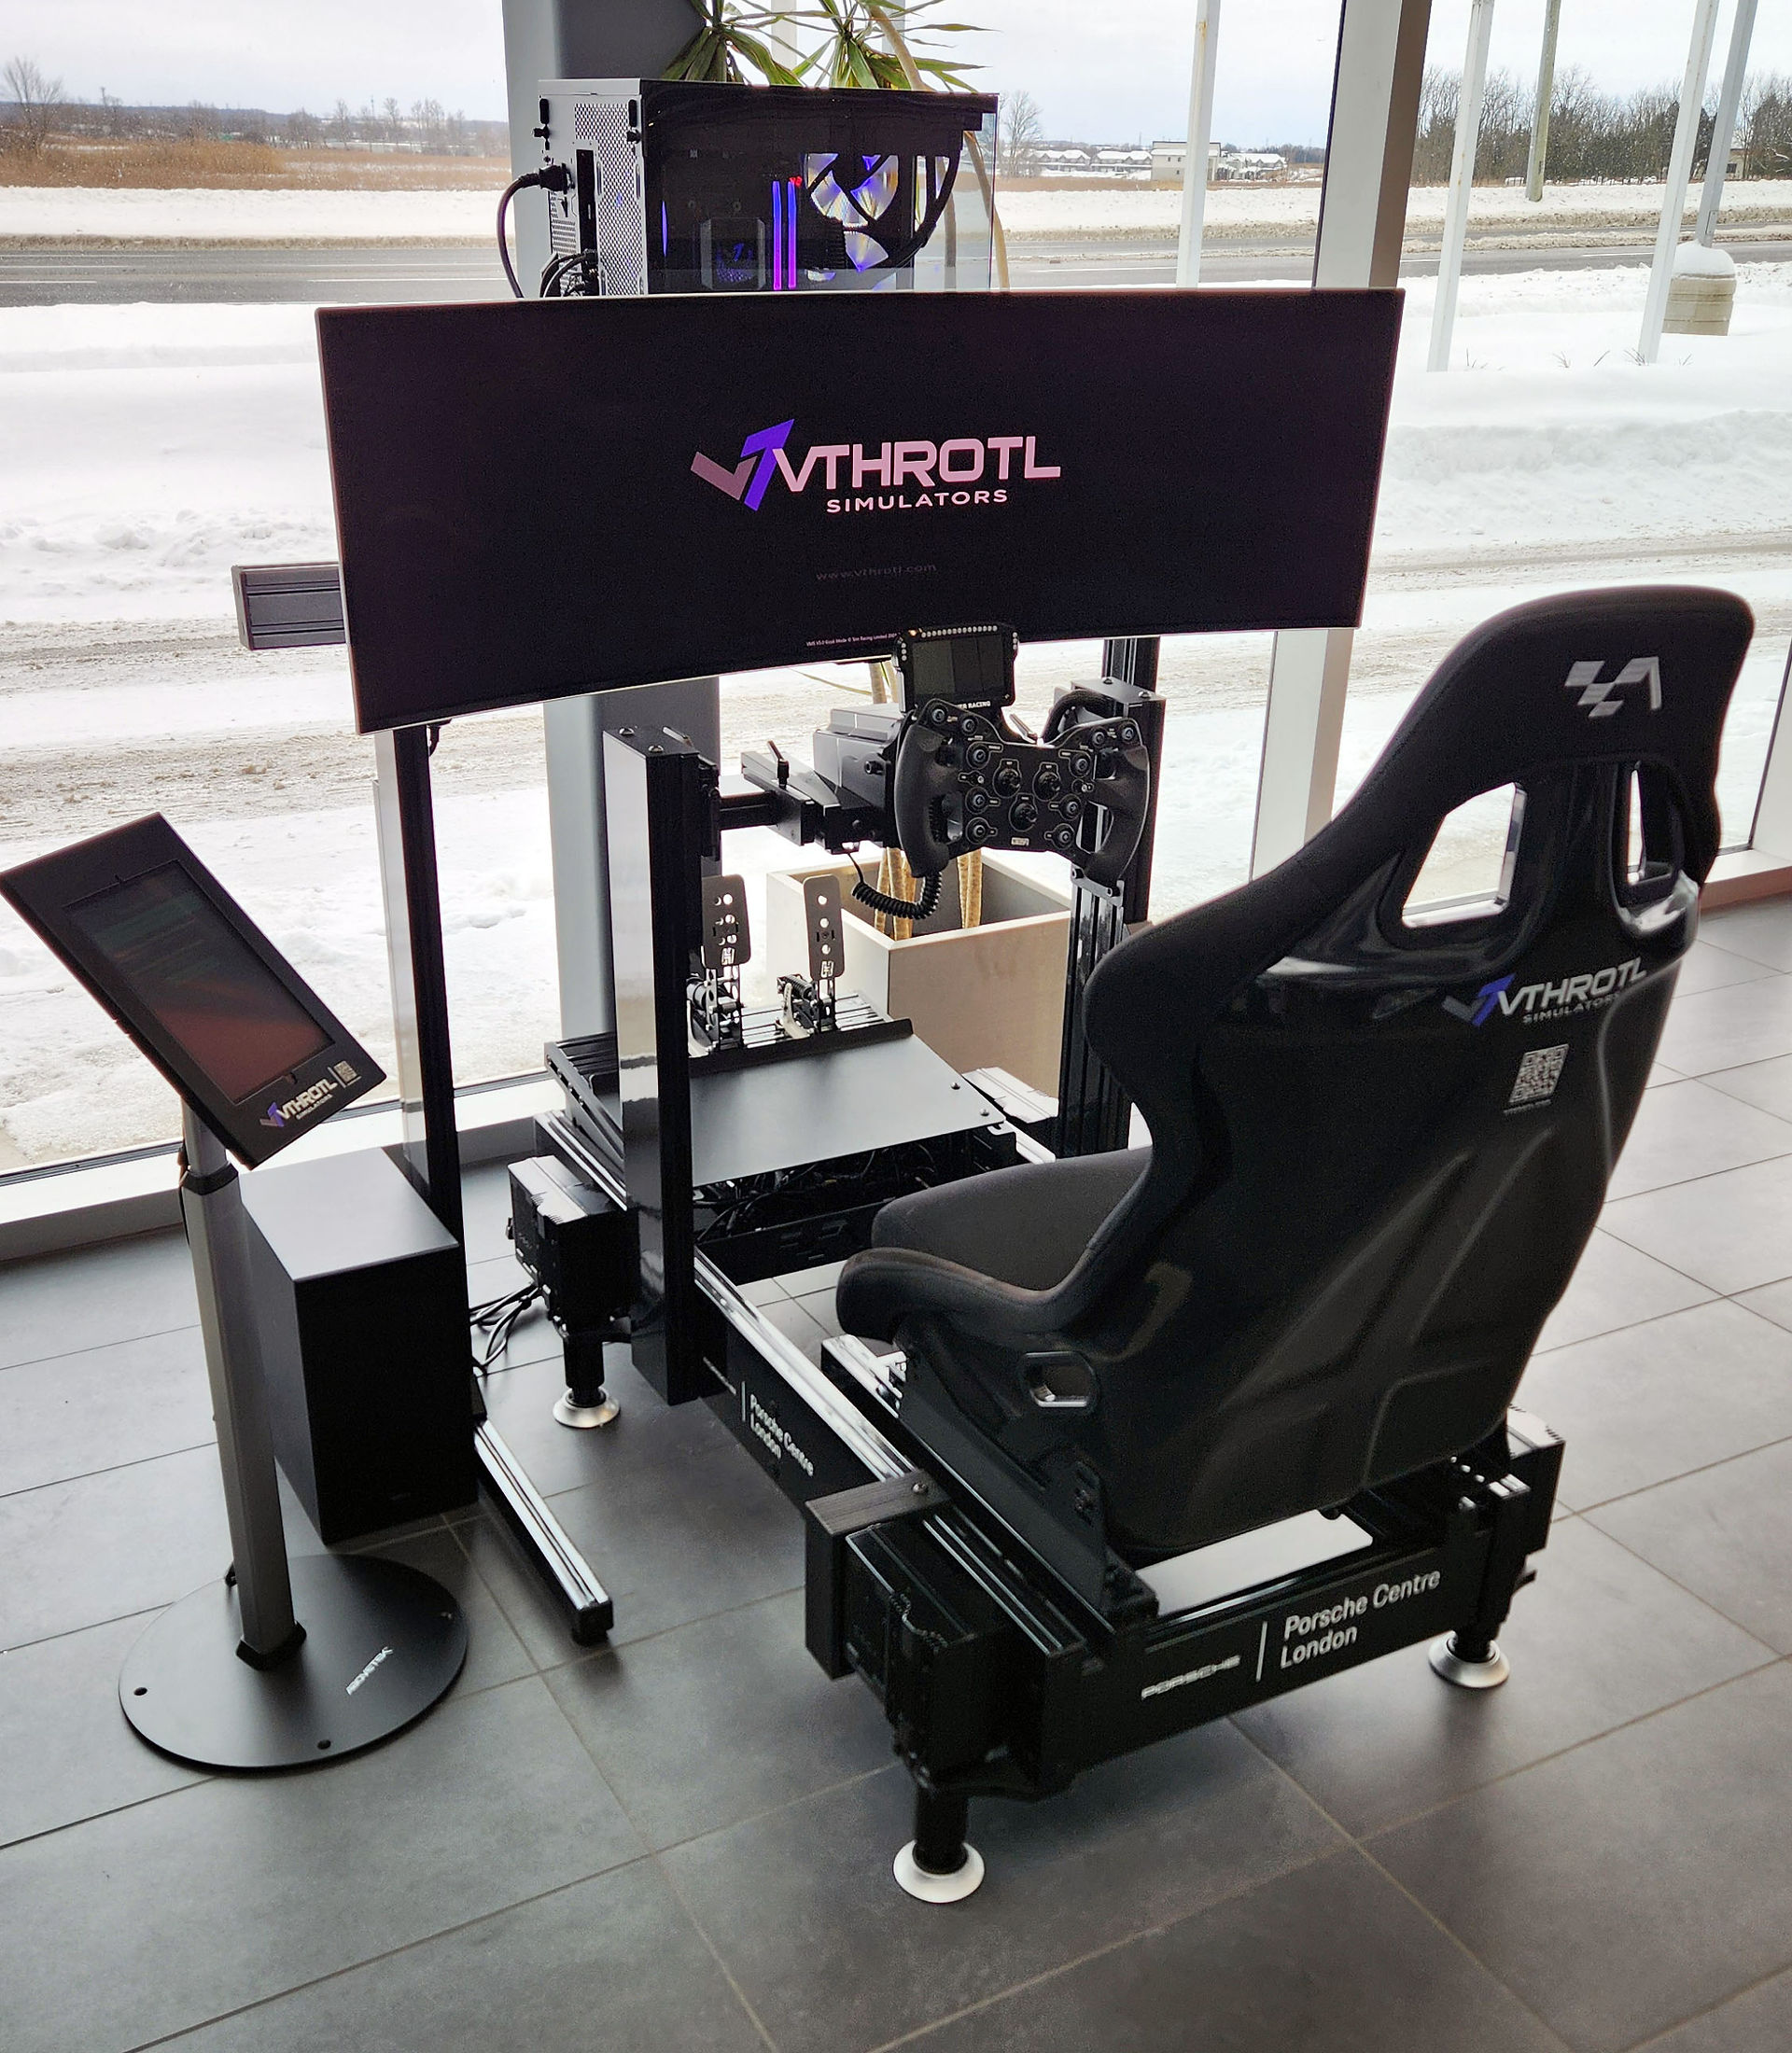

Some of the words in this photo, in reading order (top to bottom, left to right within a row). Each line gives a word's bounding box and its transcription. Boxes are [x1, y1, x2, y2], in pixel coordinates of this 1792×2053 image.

[772, 436, 1060, 492] VTHROTL
[827, 489, 1008, 513] SIMULATORS
[968, 700, 991, 709] RACING
[1497, 957, 1646, 1015] VTHROTL
[275, 1078, 338, 1120] VTHROTL
[1283, 1595, 1368, 1641] Porsche
[1373, 1571, 1441, 1609] Centre
[1281, 1627, 1358, 1669] London
[1141, 1655, 1240, 1700] PORSCHE
